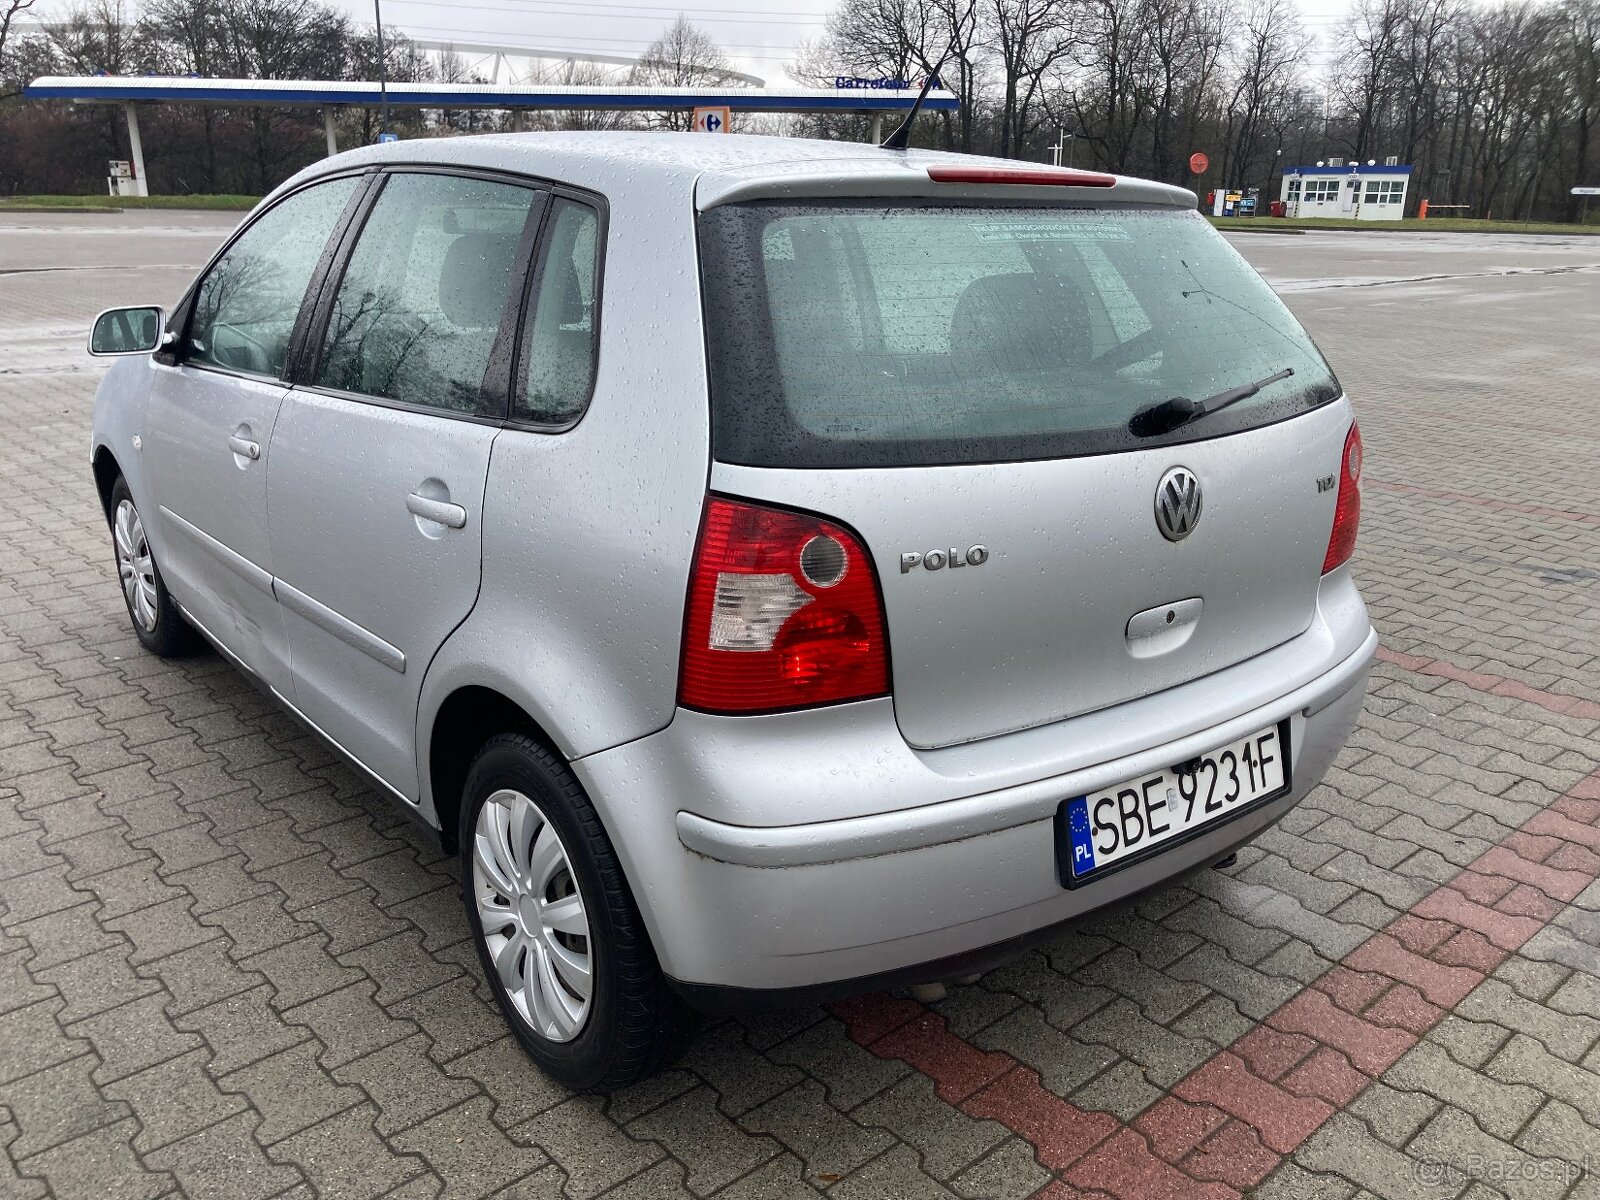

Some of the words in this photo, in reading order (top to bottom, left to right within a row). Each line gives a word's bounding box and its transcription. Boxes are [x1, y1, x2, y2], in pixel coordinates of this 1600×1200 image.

[900, 543, 989, 573] POLO
[1093, 776, 1170, 855] SBE
[1178, 731, 1275, 823] 9231F
[1075, 845, 1092, 862] PL
